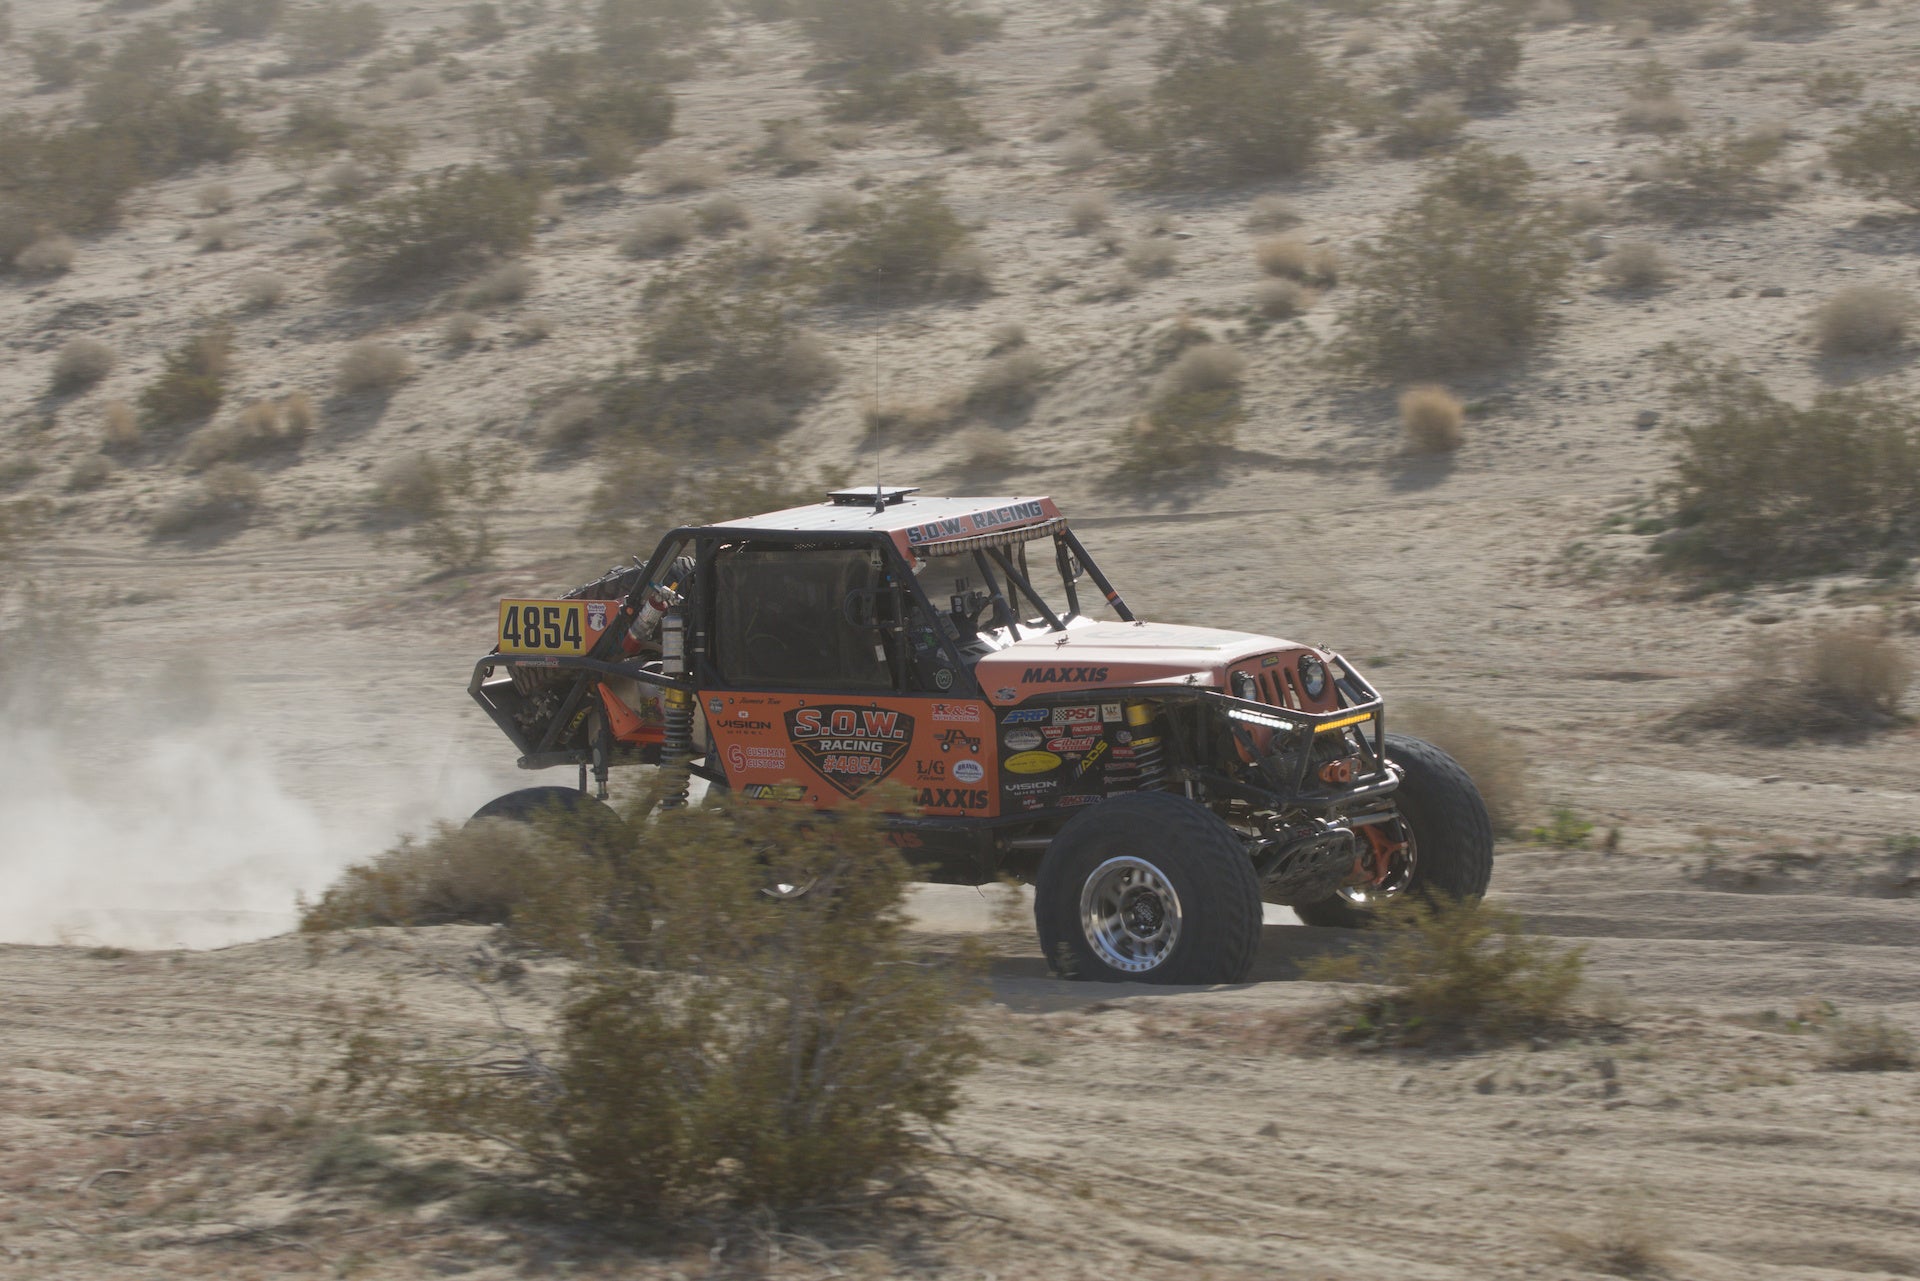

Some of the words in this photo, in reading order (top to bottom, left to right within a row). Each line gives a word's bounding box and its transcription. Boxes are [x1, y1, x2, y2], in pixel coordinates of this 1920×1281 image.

[906, 518, 967, 543] S.O.W.
[970, 500, 1043, 530] RACING
[503, 606, 582, 649] 4854
[1021, 667, 1109, 684] MAXXIS
[1065, 708, 1096, 720] PSC
[717, 720, 771, 729] VISION
[794, 709, 904, 738] S.O.W.
[819, 740, 883, 752] RACING
[746, 760, 785, 769] CUSTOMS
[1081, 740, 1109, 772] ADS
[823, 755, 883, 775] #4854
[1005, 781, 1057, 791] VISION
